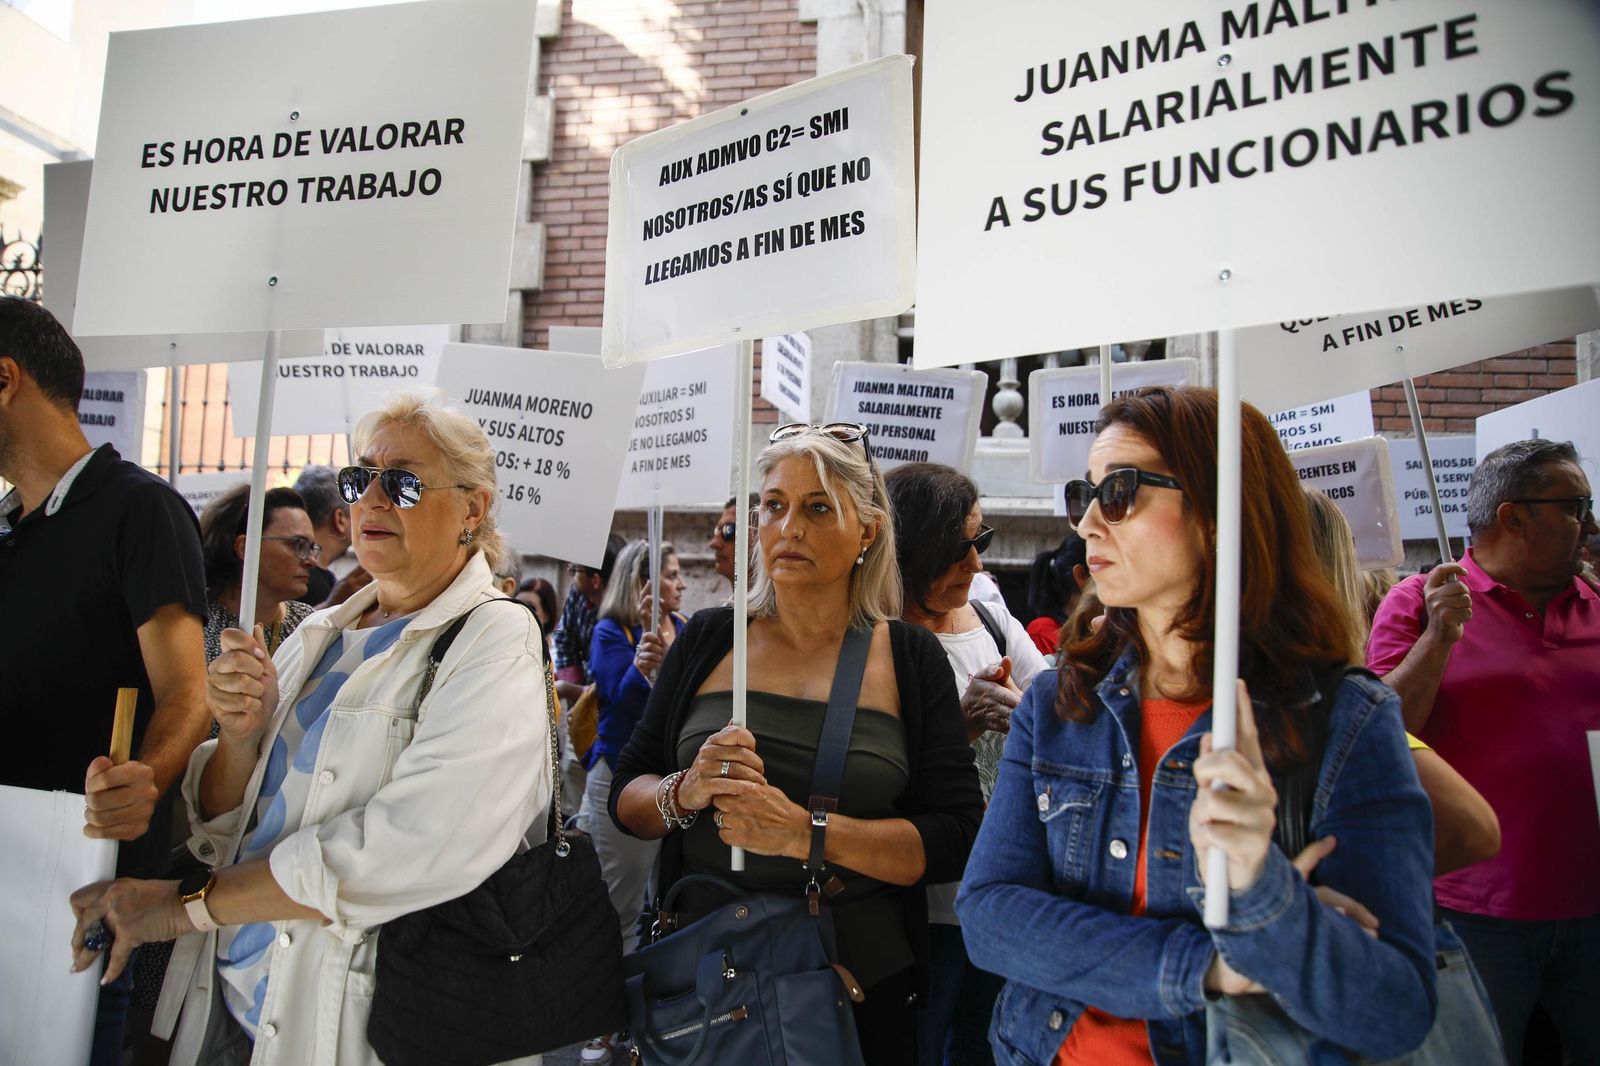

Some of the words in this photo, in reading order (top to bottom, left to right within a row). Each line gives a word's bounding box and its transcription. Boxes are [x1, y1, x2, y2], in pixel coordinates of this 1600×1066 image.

[1014, 20, 1207, 103] JUANMA
[1040, 13, 1478, 156] SALARIALMENTE
[141, 141, 175, 168] ES
[183, 134, 264, 165] HORA
[272, 130, 312, 158] DE
[320, 118, 465, 154] VALORAR
[659, 156, 693, 187] AUX
[696, 134, 761, 176] ADMVO
[766, 124, 805, 152] C2=
[809, 107, 849, 140] SMI
[984, 195, 1011, 232] A
[1022, 173, 1108, 223] SUS
[1123, 70, 1575, 202] FUNCIONARIOS
[150, 179, 288, 214] NUESTRO
[297, 168, 442, 203] TRABAJO
[643, 184, 768, 241] NOSOTROS/AS
[773, 172, 793, 203] SÍ
[797, 165, 836, 198] QUE
[841, 156, 871, 185] NO
[645, 241, 732, 286] LLEGAMOS
[736, 237, 750, 261] A
[754, 228, 785, 257] FIN
[790, 221, 815, 249] DE
[820, 210, 865, 243] MES
[1322, 333, 1339, 352] A
[1342, 320, 1383, 346] FIN
[1388, 308, 1422, 333] DE
[1427, 298, 1482, 322] MES
[331, 342, 351, 355] DE
[355, 343, 424, 355] VALORAR
[276, 364, 345, 378] UESTRO
[350, 364, 418, 377] TRABAJO
[82, 388, 124, 403] ALORAR
[689, 381, 707, 397] SMI
[853, 381, 894, 395] JUANMA
[896, 383, 955, 400] MALTRATA
[465, 388, 522, 410] JUANMA
[525, 395, 593, 420] MORENO
[1052, 396, 1065, 409] ES
[1068, 392, 1099, 407] HORA
[685, 407, 695, 421] SI
[858, 401, 942, 420] SALARIALMENTE
[1266, 411, 1296, 424] LIAR
[1311, 404, 1335, 417] SMI
[487, 420, 516, 439] SUS
[518, 425, 565, 447] ALTOS
[881, 424, 936, 441] PERSONAL
[1059, 420, 1097, 436] NUEST
[1309, 422, 1322, 434] SI
[640, 436, 653, 450] NO
[655, 428, 707, 448] LLEGAMOS
[870, 445, 928, 462] NCIONARIO
[534, 458, 553, 476] 18
[631, 461, 638, 473] A
[639, 459, 654, 472] FIN
[656, 457, 668, 471] DE
[670, 454, 691, 469] MES
[1342, 460, 1356, 474] EN
[506, 484, 525, 501] 16
